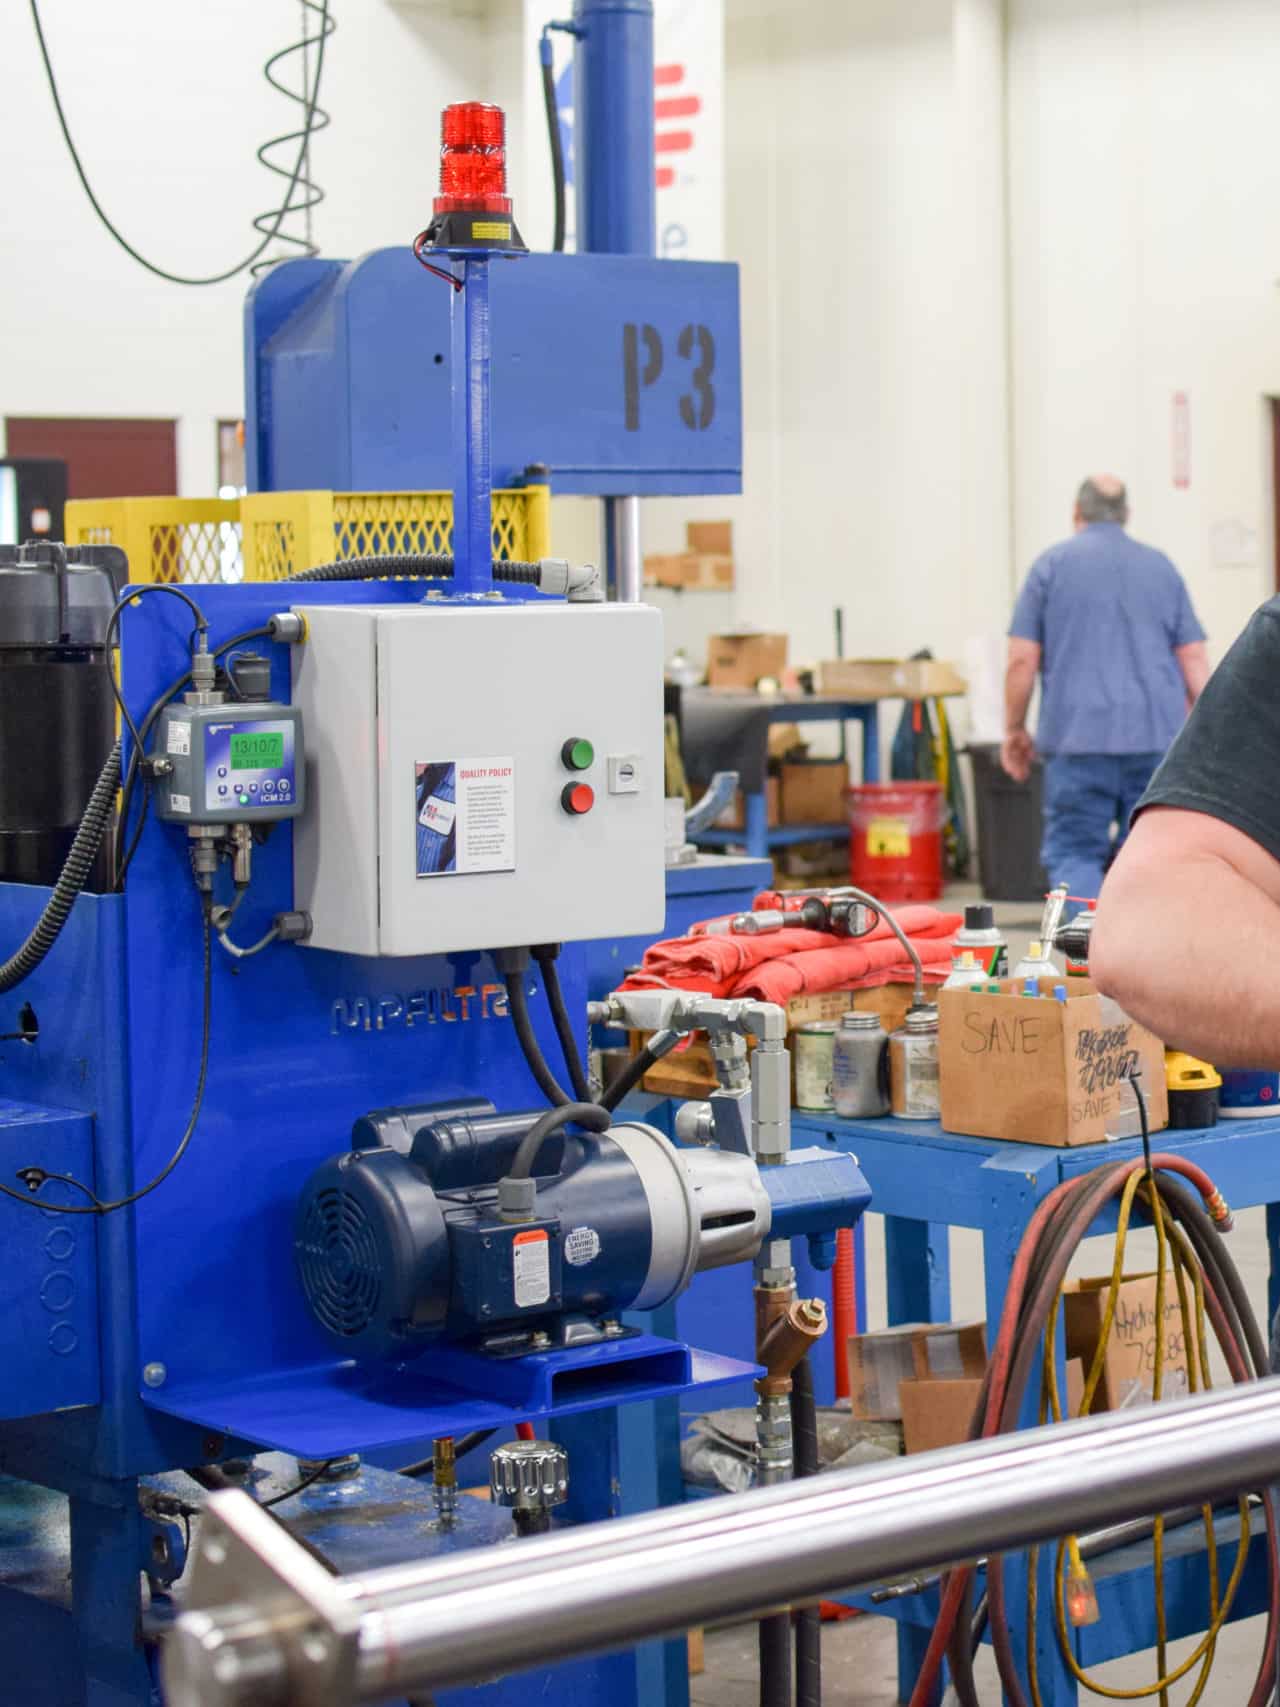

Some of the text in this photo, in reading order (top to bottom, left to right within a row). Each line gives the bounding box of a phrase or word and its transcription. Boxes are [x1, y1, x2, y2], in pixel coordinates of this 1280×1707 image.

[624, 323, 715, 432] P3
[459, 767, 512, 779] QUALITY POLICY
[261, 794, 278, 802] ICM
[961, 1012, 1042, 1055] SAVE
[1071, 1096, 1112, 1122] SAVE
